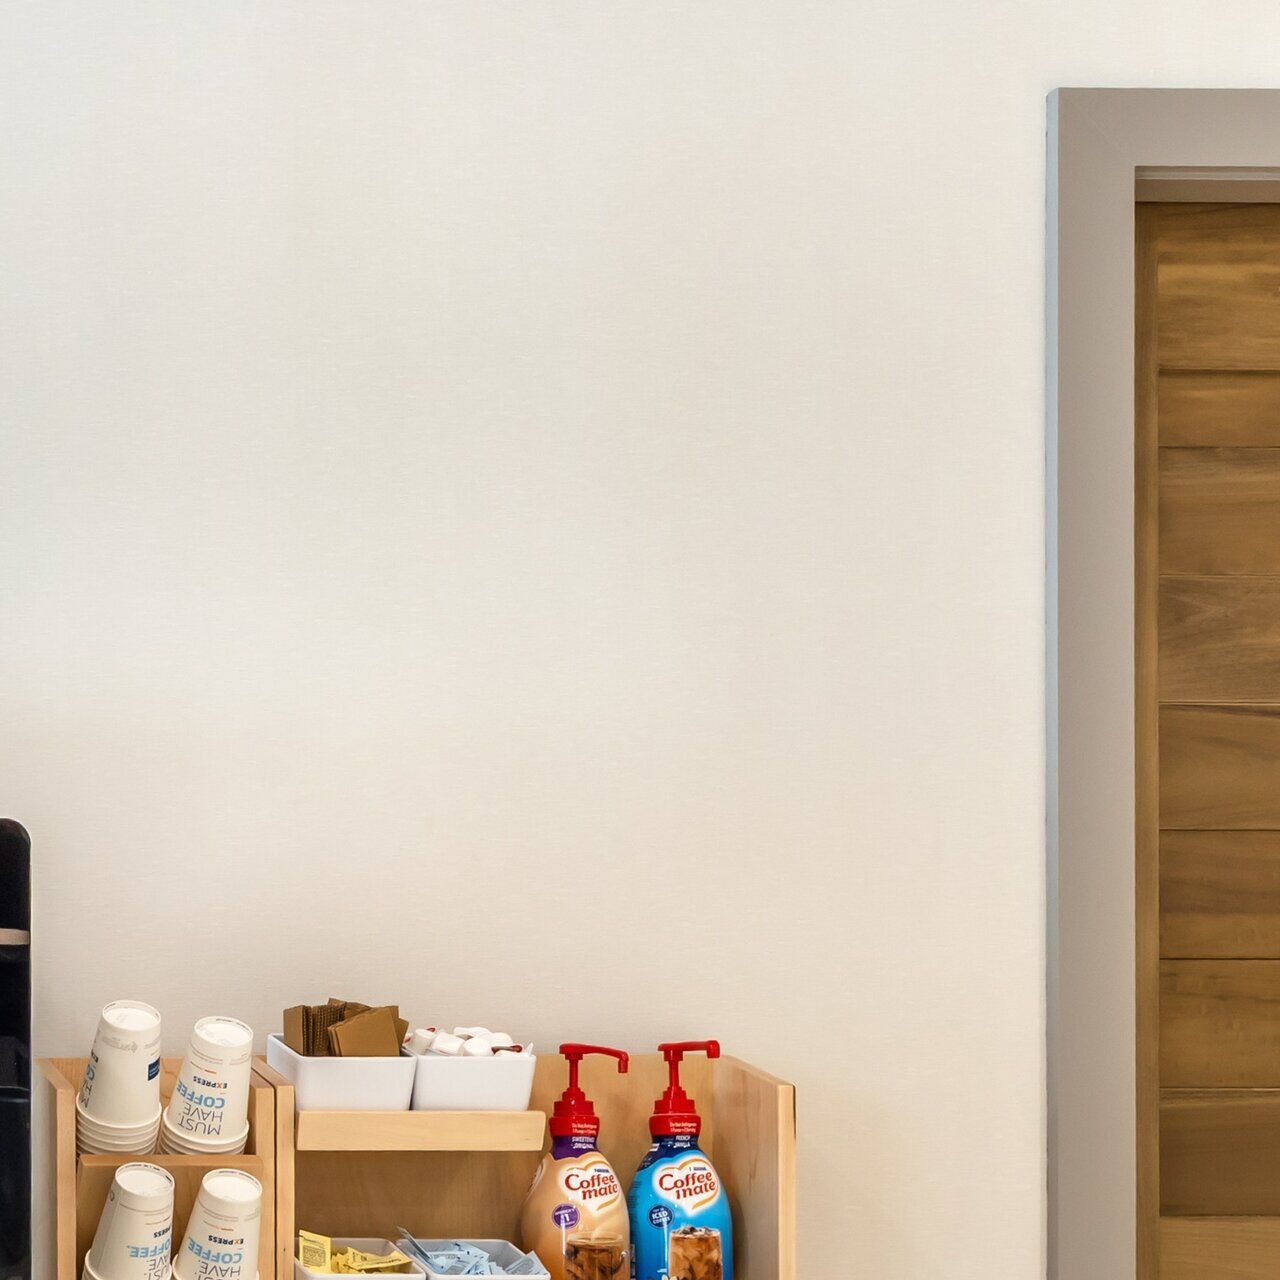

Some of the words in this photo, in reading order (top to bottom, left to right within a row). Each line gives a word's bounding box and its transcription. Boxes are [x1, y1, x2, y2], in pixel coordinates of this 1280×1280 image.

[193, 1075, 228, 1090] EXPRESS
[565, 1174, 616, 1191] Coffee
[659, 1171, 713, 1191] Coffee
[581, 1183, 618, 1200] mate
[652, 1210, 668, 1219] ICED
[127, 1238, 171, 1258] OFFEE.
[208, 1234, 244, 1246] EXPRESS
[146, 1254, 171, 1271] AVE.
[196, 1260, 242, 1278] HAVE.
